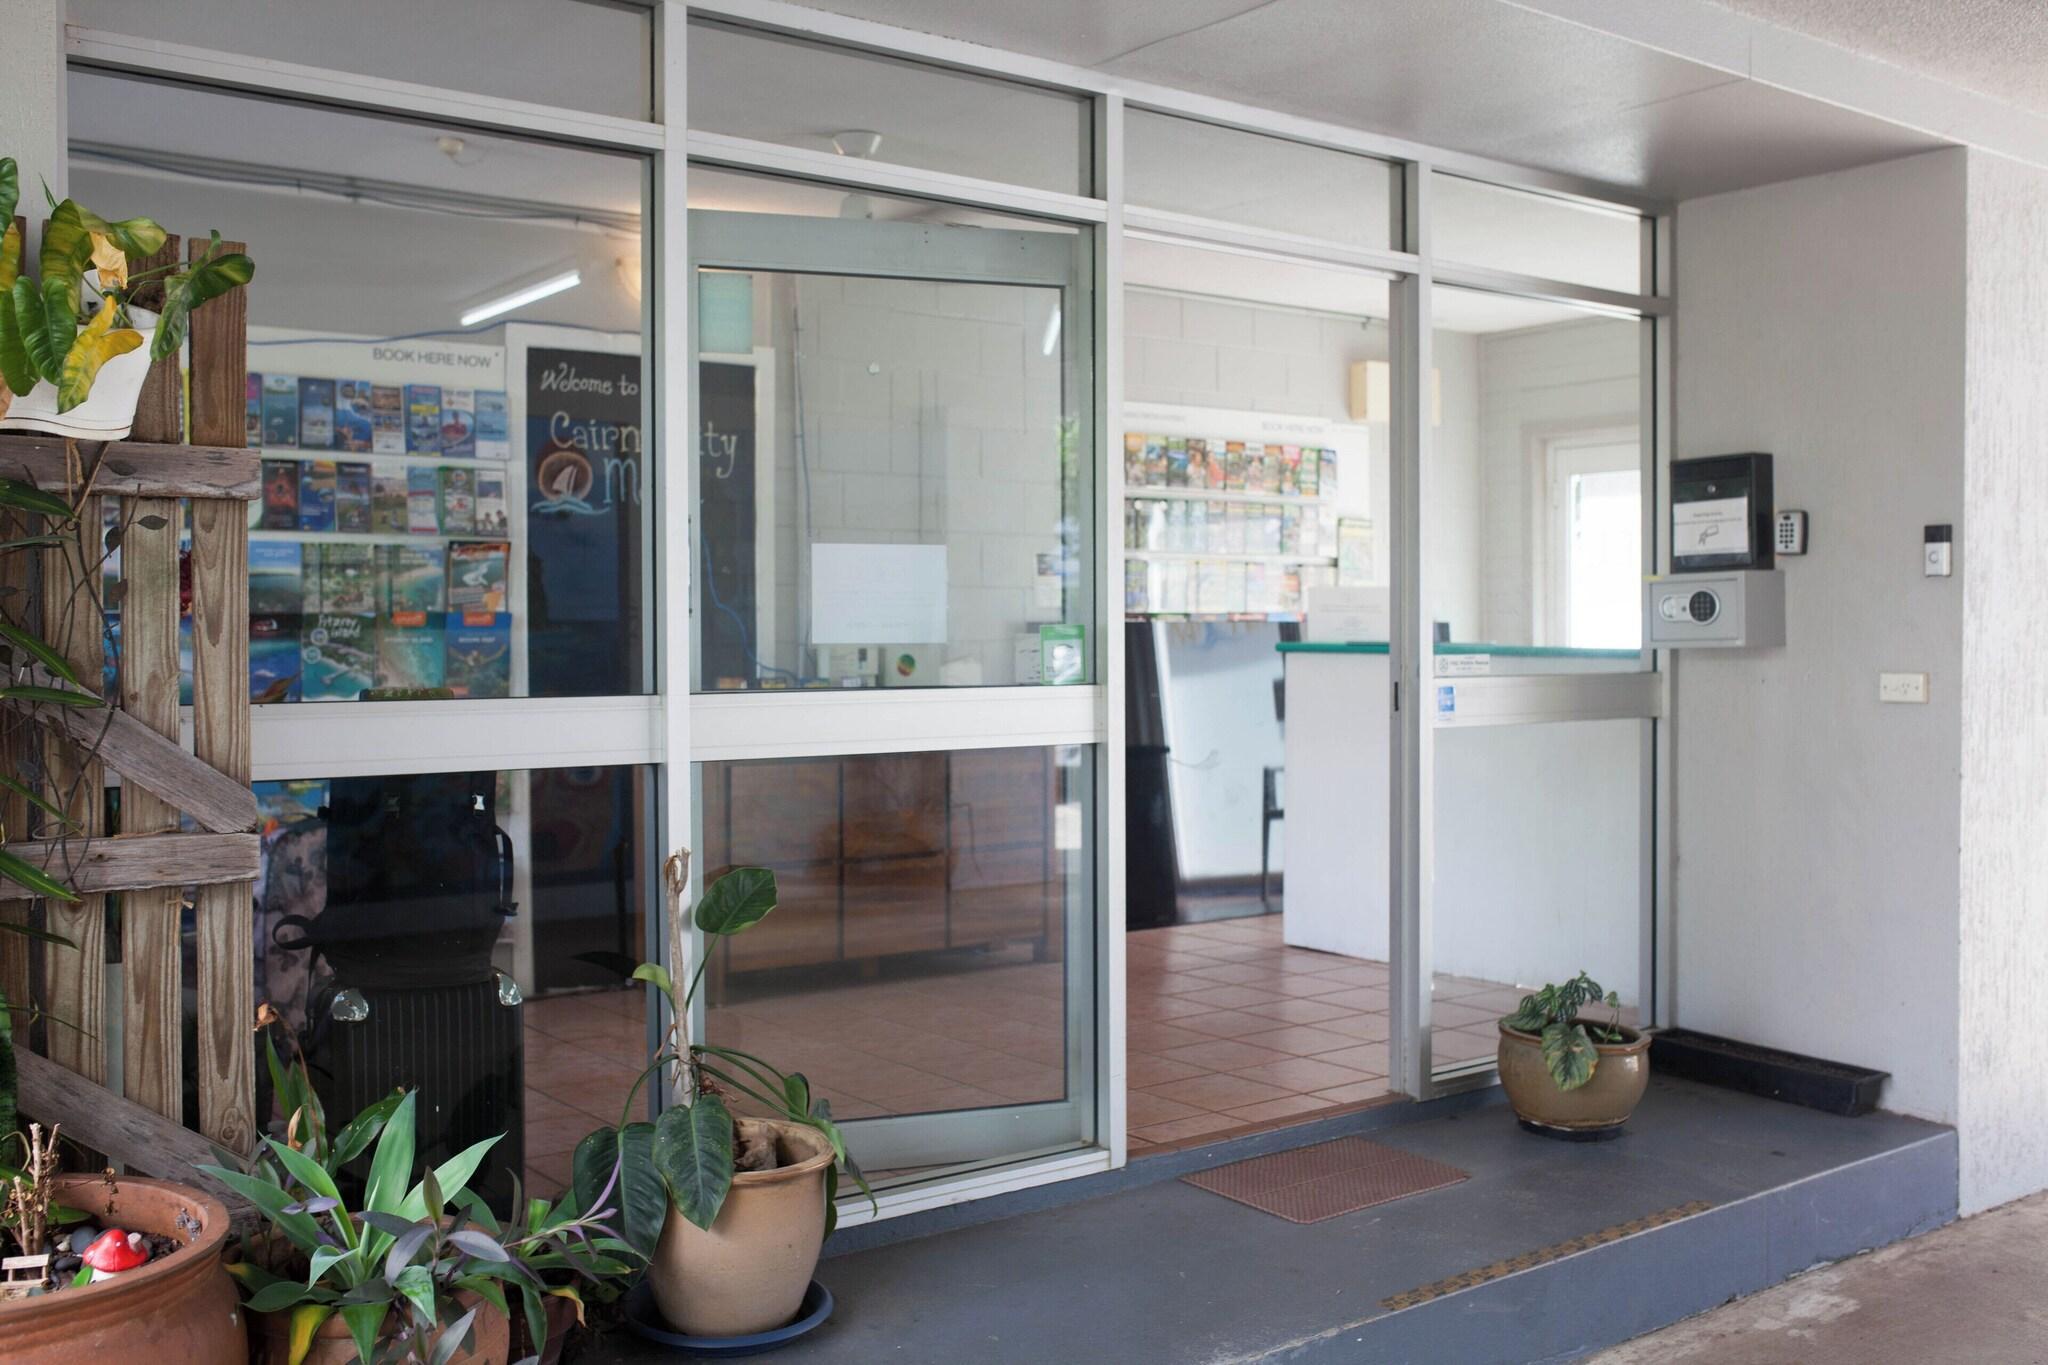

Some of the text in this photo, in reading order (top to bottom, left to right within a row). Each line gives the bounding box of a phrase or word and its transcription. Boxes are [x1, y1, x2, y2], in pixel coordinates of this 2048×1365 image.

[373, 347, 491, 368] BOOK HERE NOW
[540, 362, 639, 396] Welcome to
[551, 411, 641, 453] Cairn
